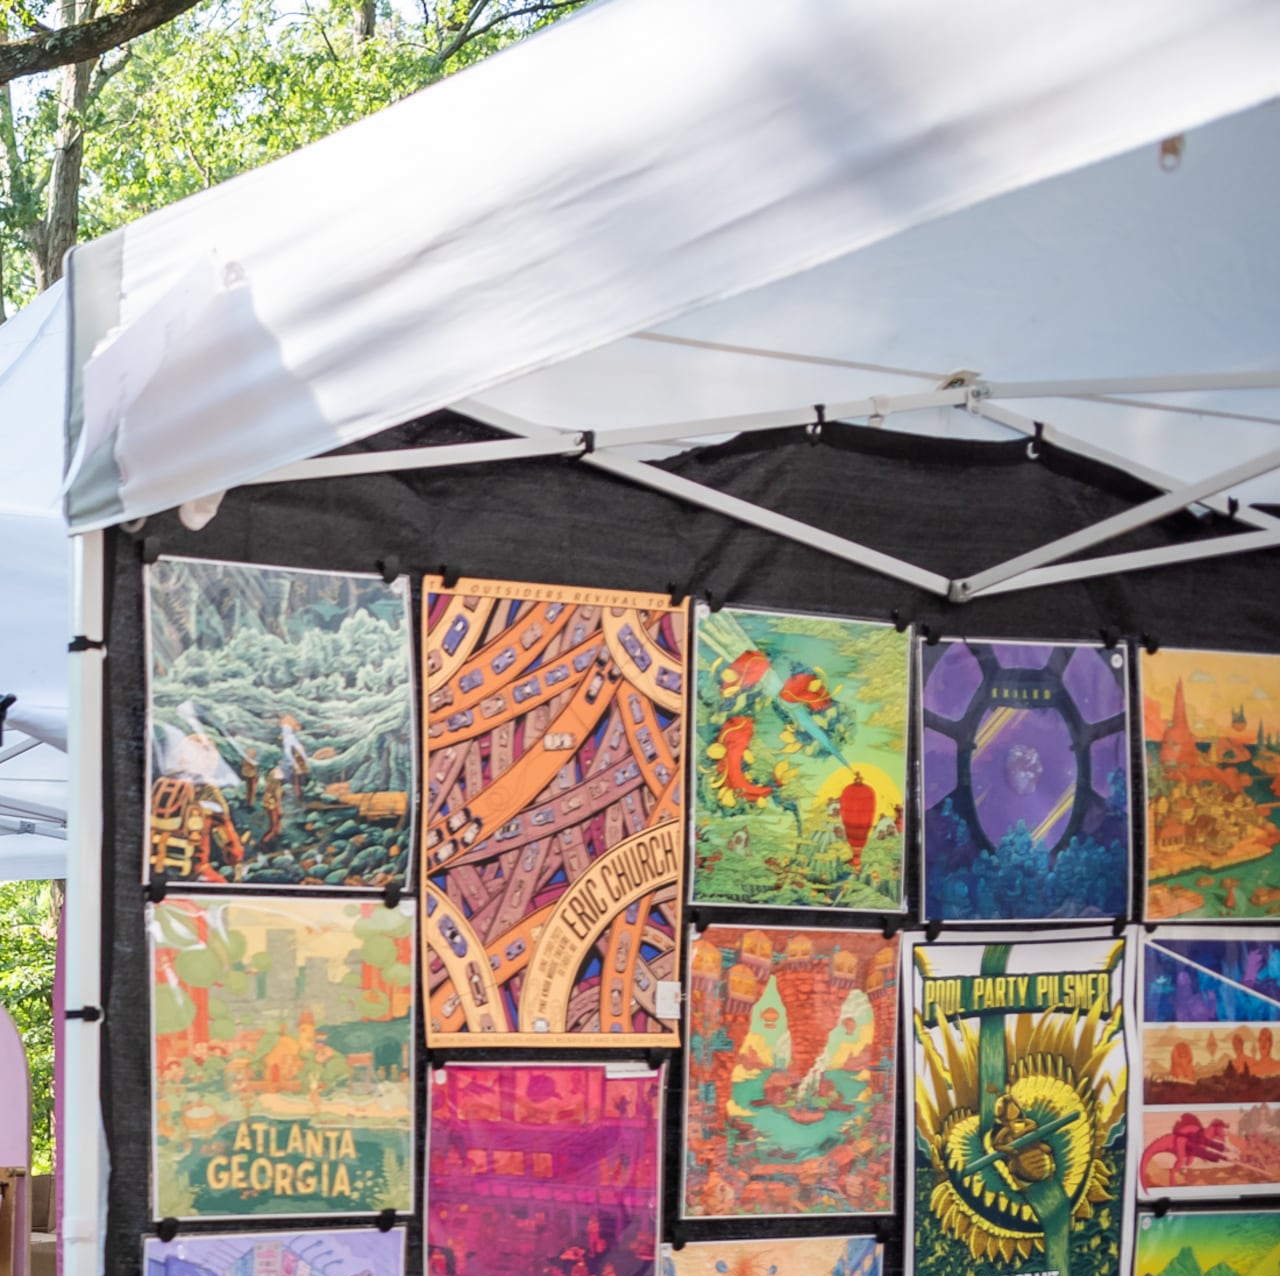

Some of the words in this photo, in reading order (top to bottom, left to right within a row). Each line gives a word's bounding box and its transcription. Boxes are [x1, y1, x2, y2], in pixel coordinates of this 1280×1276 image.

[470, 584, 563, 600] OUTSIDERS
[574, 592, 638, 607] REVIVAL
[561, 878, 608, 940] ERIC
[600, 830, 678, 902] CHURCH
[924, 978, 966, 1021] POOL
[973, 976, 1029, 1010] PARTY
[1036, 972, 1110, 1013] PILSNER
[233, 1121, 357, 1160] ATLANTA
[206, 1154, 352, 1197] GEORGIA
